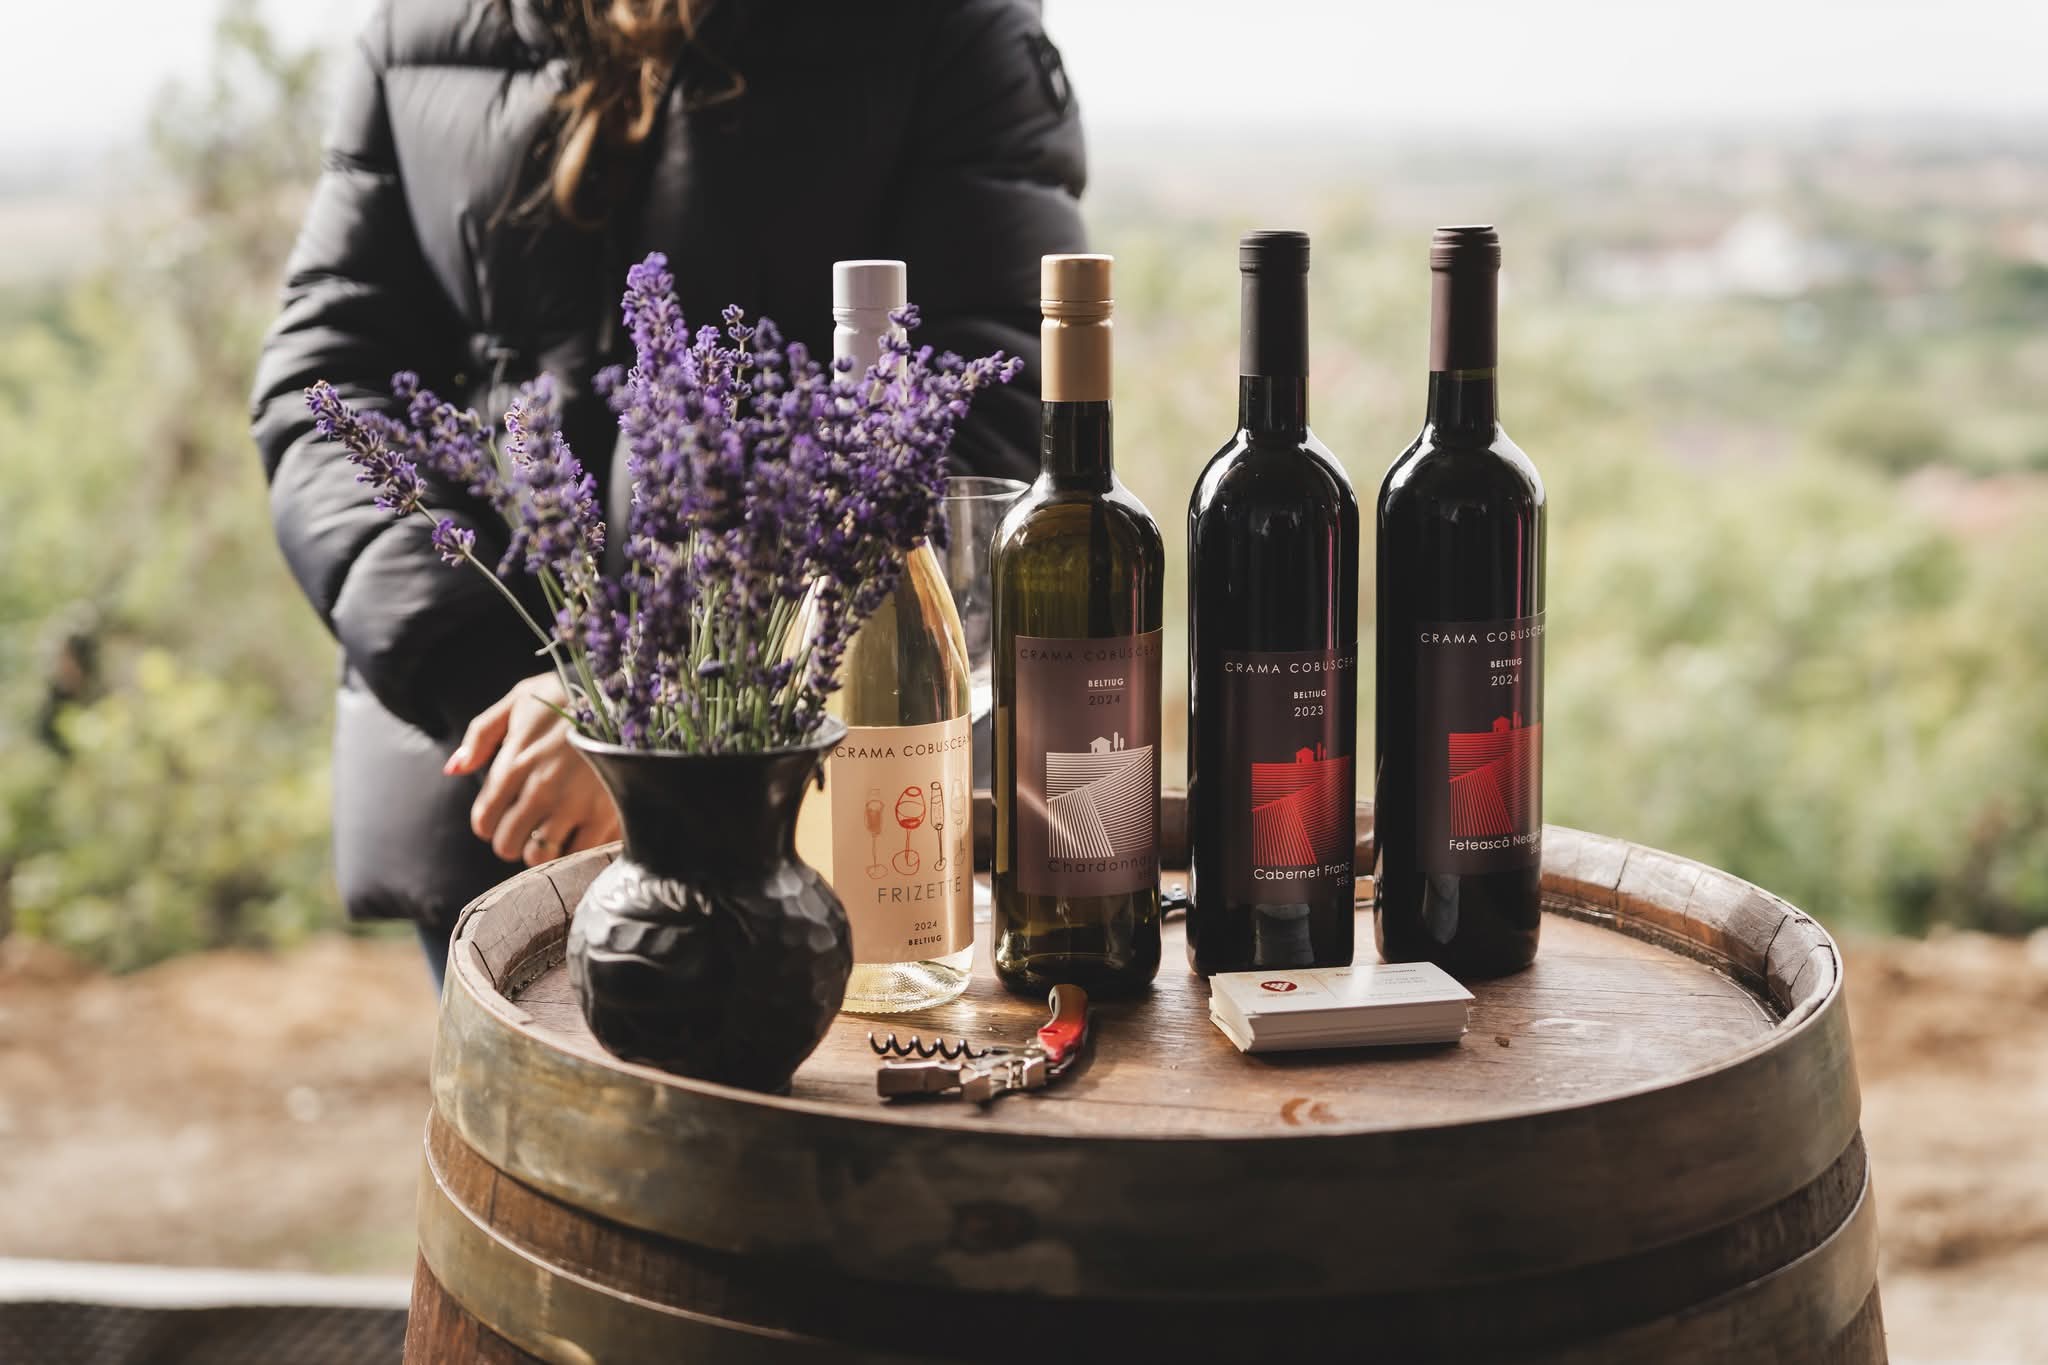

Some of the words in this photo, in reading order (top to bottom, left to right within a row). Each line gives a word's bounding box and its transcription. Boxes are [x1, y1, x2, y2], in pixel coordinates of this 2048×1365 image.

[1419, 632, 1477, 644] CRAMA
[1019, 647, 1073, 662] CRAMA
[1224, 661, 1281, 674] CRAMA
[1490, 658, 1523, 669] BELTIUG
[1087, 678, 1125, 688] BELTIUG
[1491, 673, 1520, 687] 2024
[1293, 689, 1327, 700] BELTIUG
[1088, 695, 1121, 707] 2024
[1294, 705, 1325, 718] 2023
[834, 745, 896, 759] CRAMA
[1253, 866, 1320, 881] Cabernet
[878, 876, 961, 904] FRIZETTE
[914, 920, 938, 931] 2024
[908, 934, 943, 946] BELTIUG
